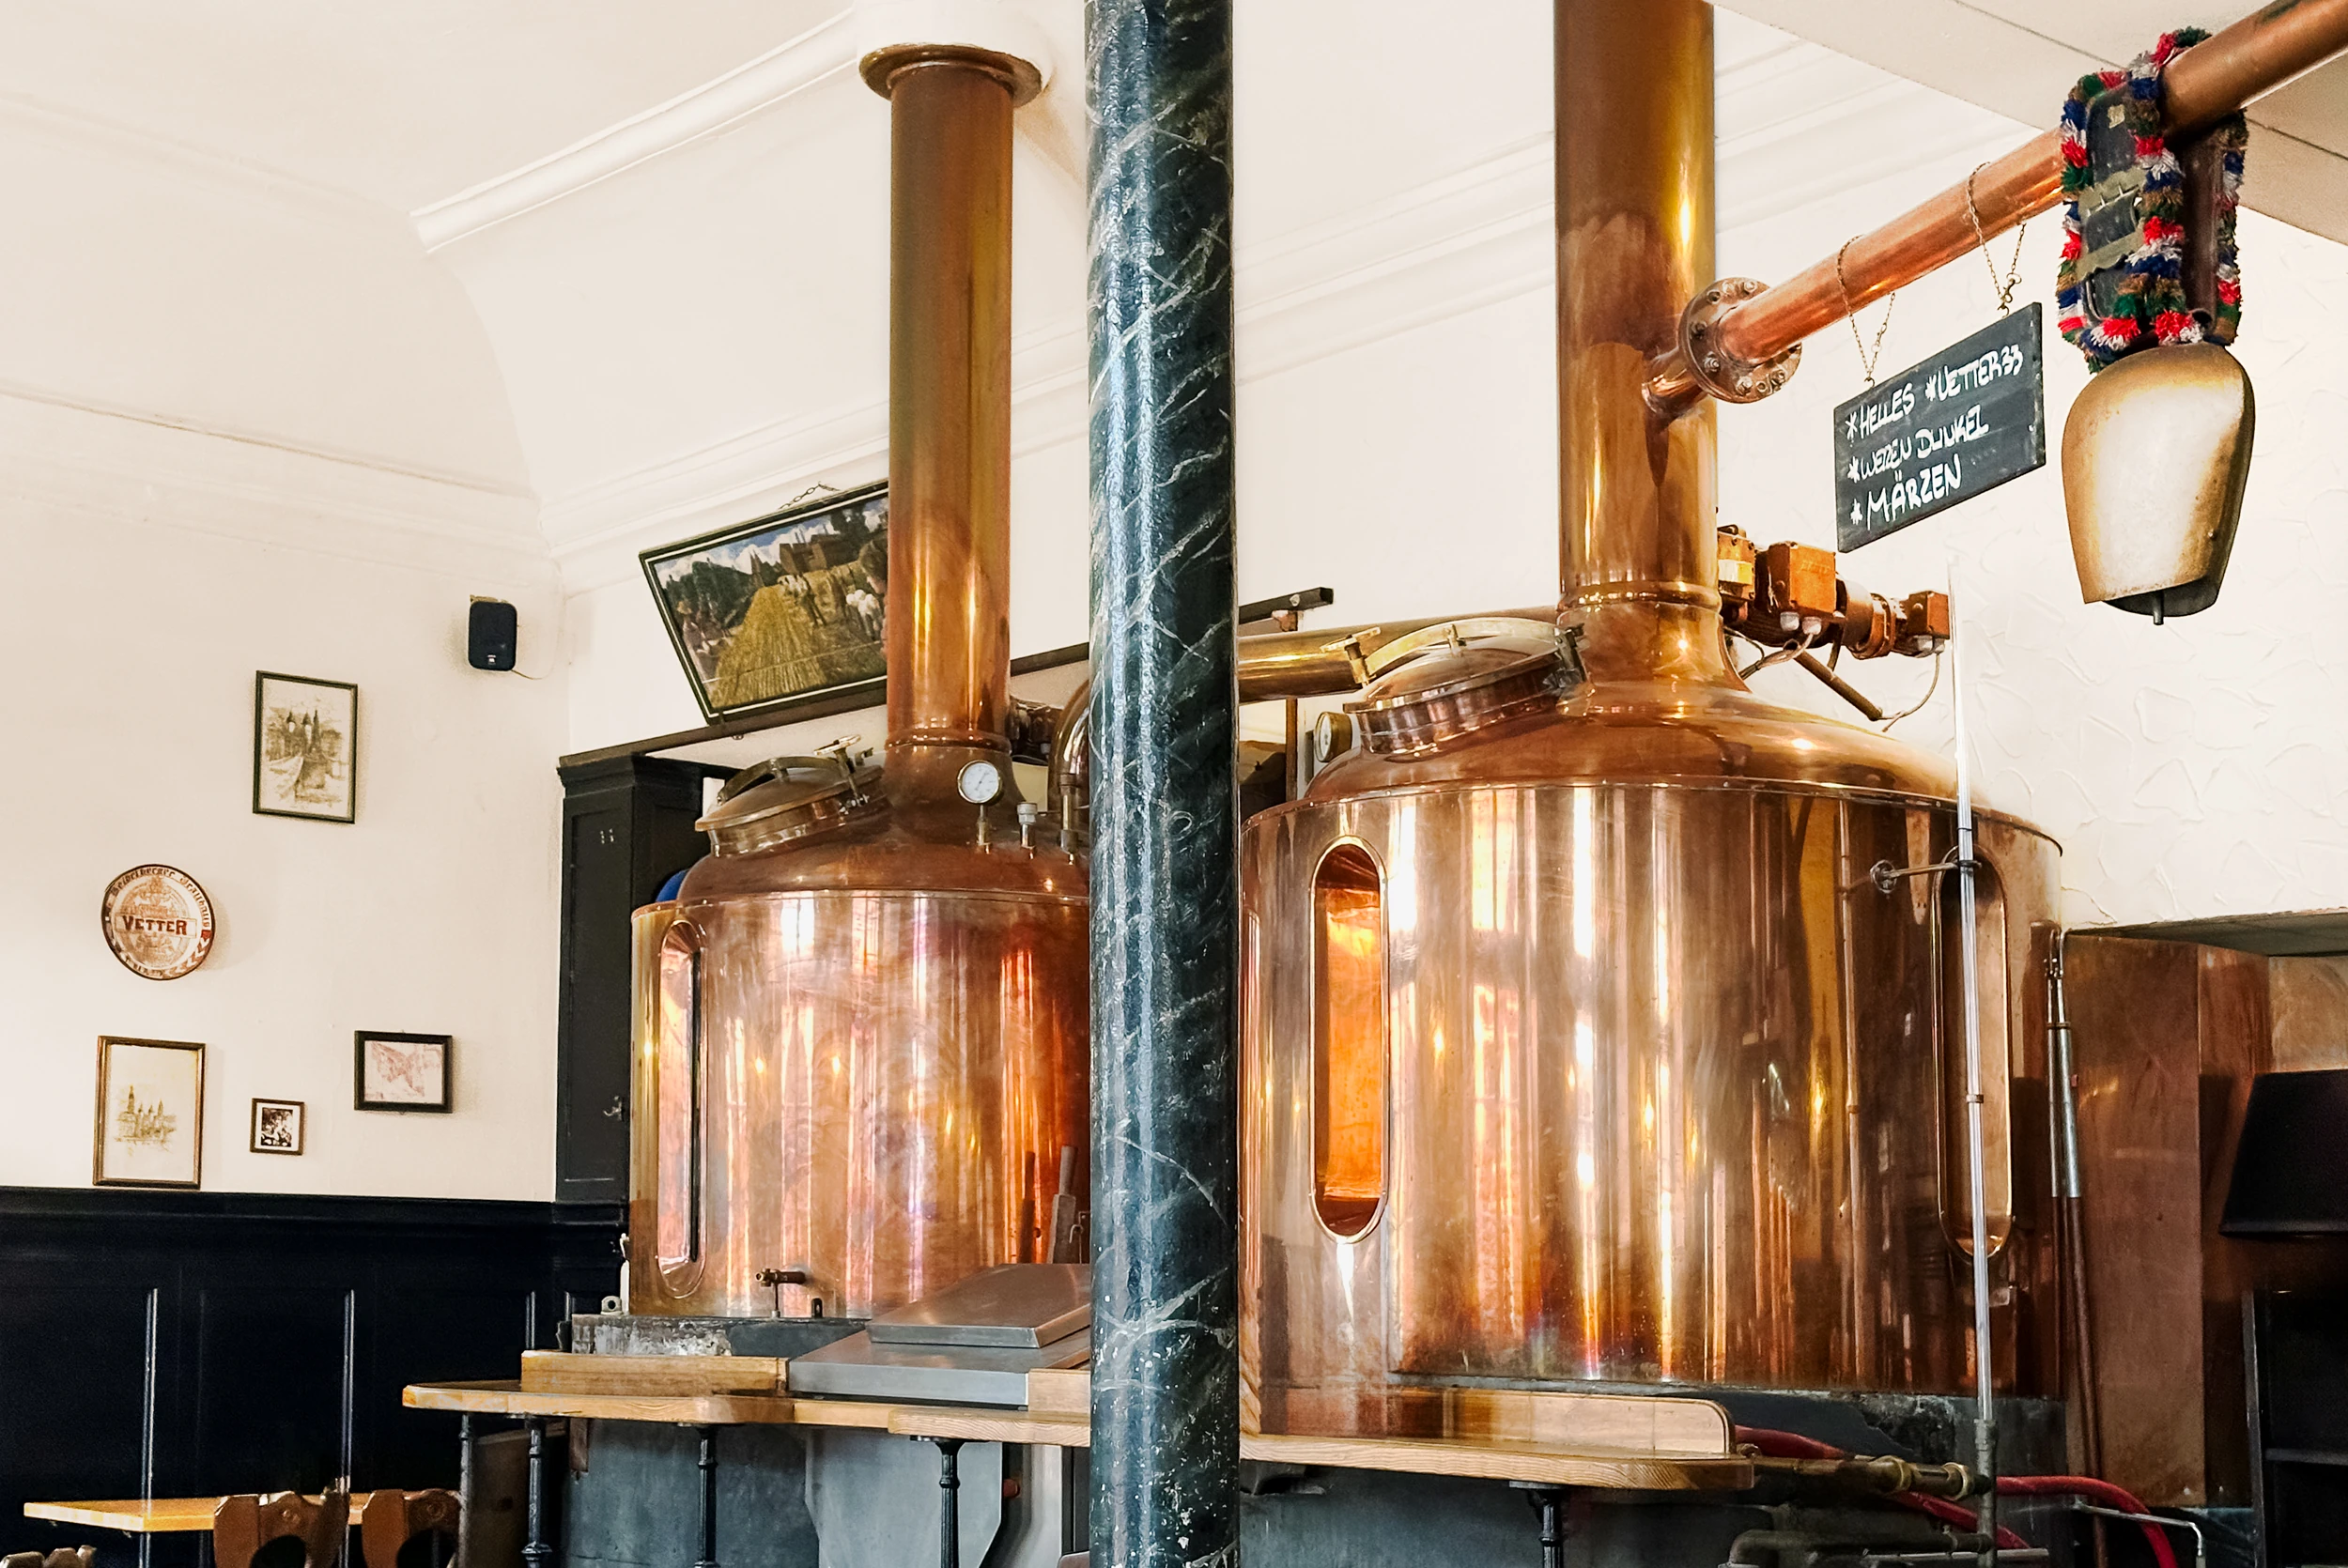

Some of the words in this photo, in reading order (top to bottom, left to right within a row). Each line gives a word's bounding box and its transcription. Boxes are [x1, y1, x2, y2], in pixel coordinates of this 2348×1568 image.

[1860, 382, 1915, 439] HELLES
[1915, 404, 1990, 459] DUNKEL
[1867, 453, 1961, 530] MÄRZEN
[122, 915, 187, 936] VETTER
